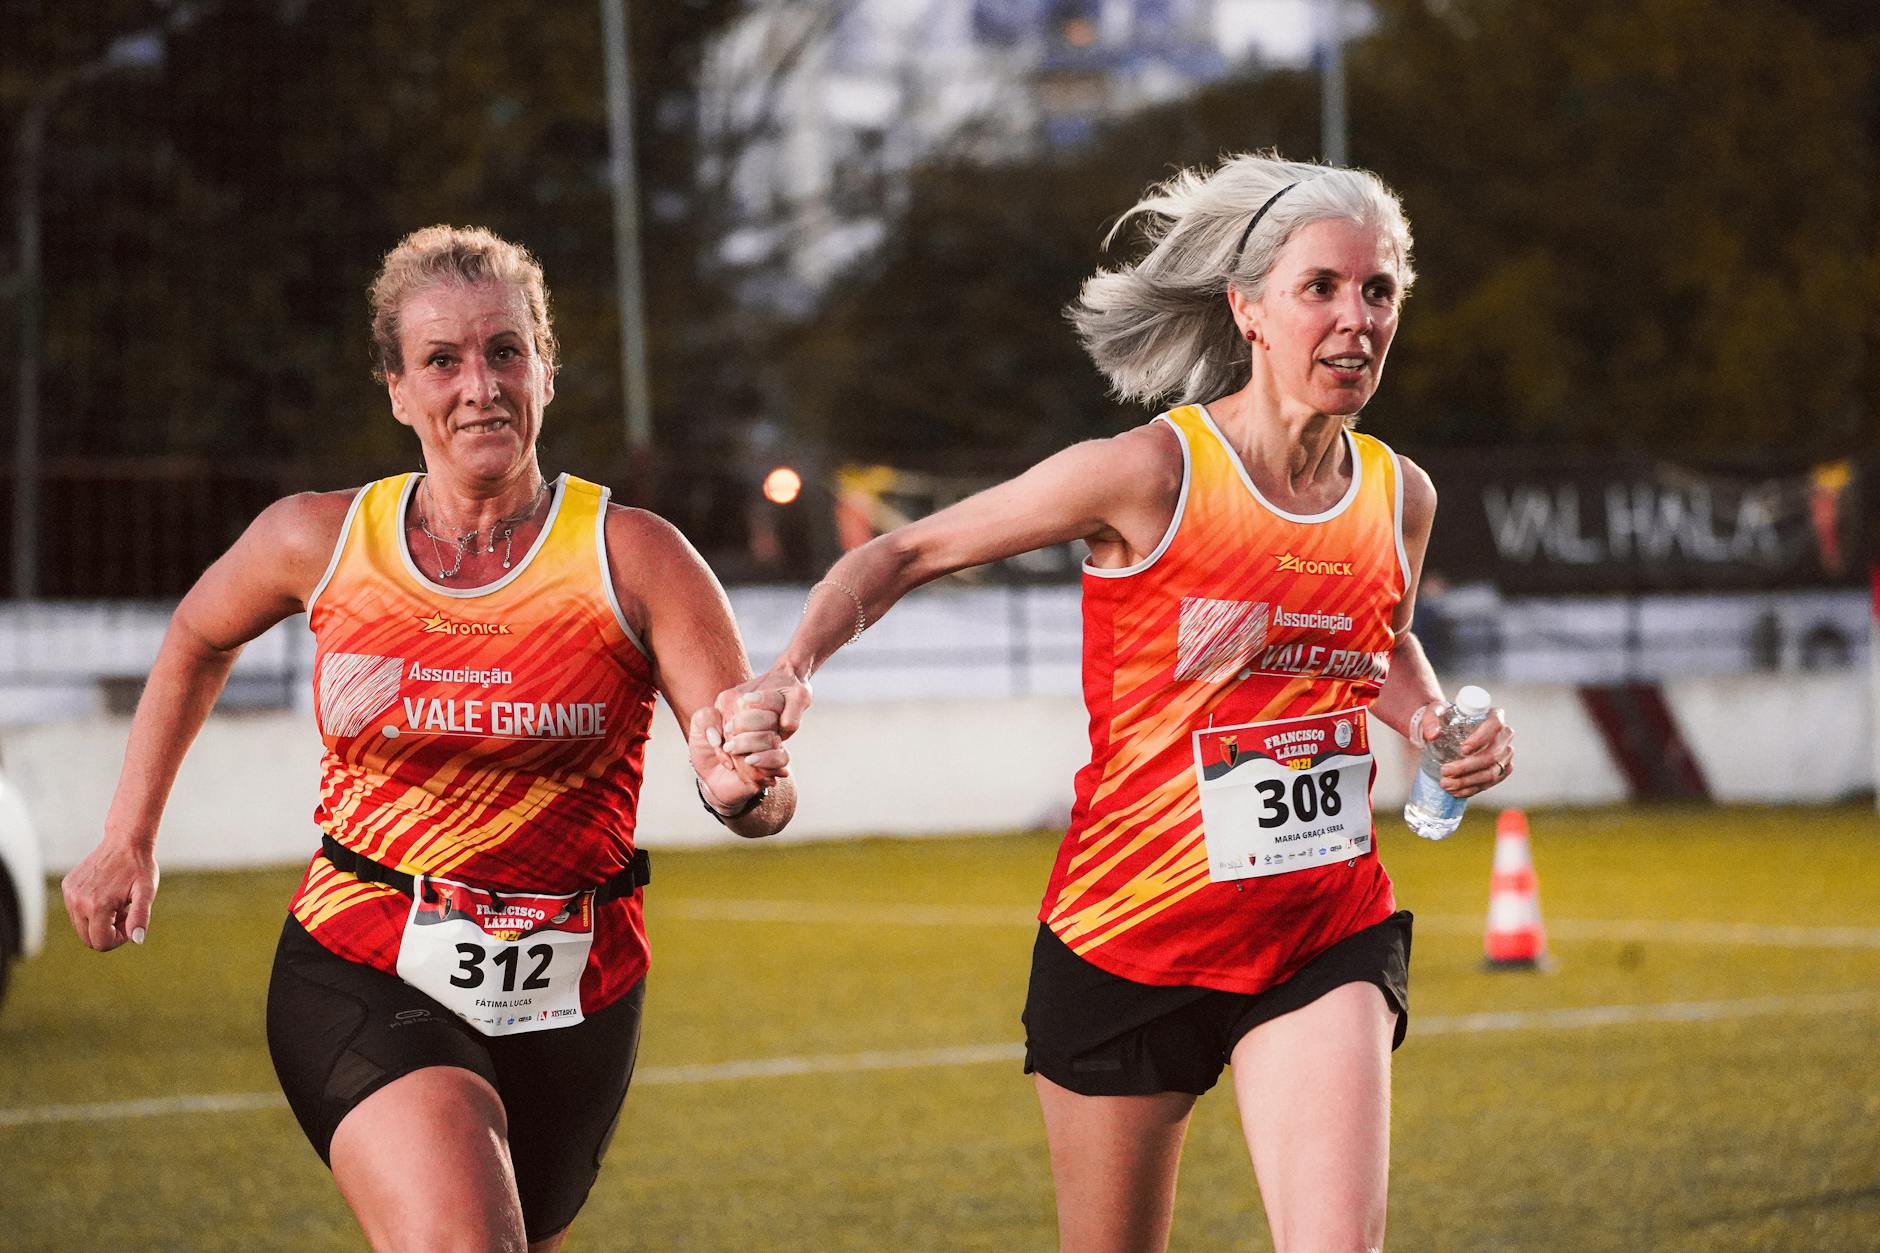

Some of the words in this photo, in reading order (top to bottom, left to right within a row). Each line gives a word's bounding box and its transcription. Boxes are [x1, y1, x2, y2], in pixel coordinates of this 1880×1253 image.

[1273, 605, 1353, 635] Associação
[1260, 644, 1325, 673] VALE
[407, 661, 513, 688] Associação
[403, 697, 484, 732] VALE
[491, 702, 607, 737] GRANDE
[1263, 729, 1325, 750] FRANCISCO
[1275, 743, 1318, 760] LÁZARO
[1286, 758, 1312, 771] 2021
[1254, 769, 1342, 829] 308
[1275, 833, 1301, 844] MARIA
[1302, 828, 1326, 839] GRAÇA
[1326, 824, 1344, 834] SERRA
[475, 903, 546, 921] FRCISCO
[484, 916, 534, 931] LÁZARO
[449, 942, 554, 992] 312
[475, 998, 508, 1008] FÁTIMA
[509, 998, 532, 1007] LUCAS
